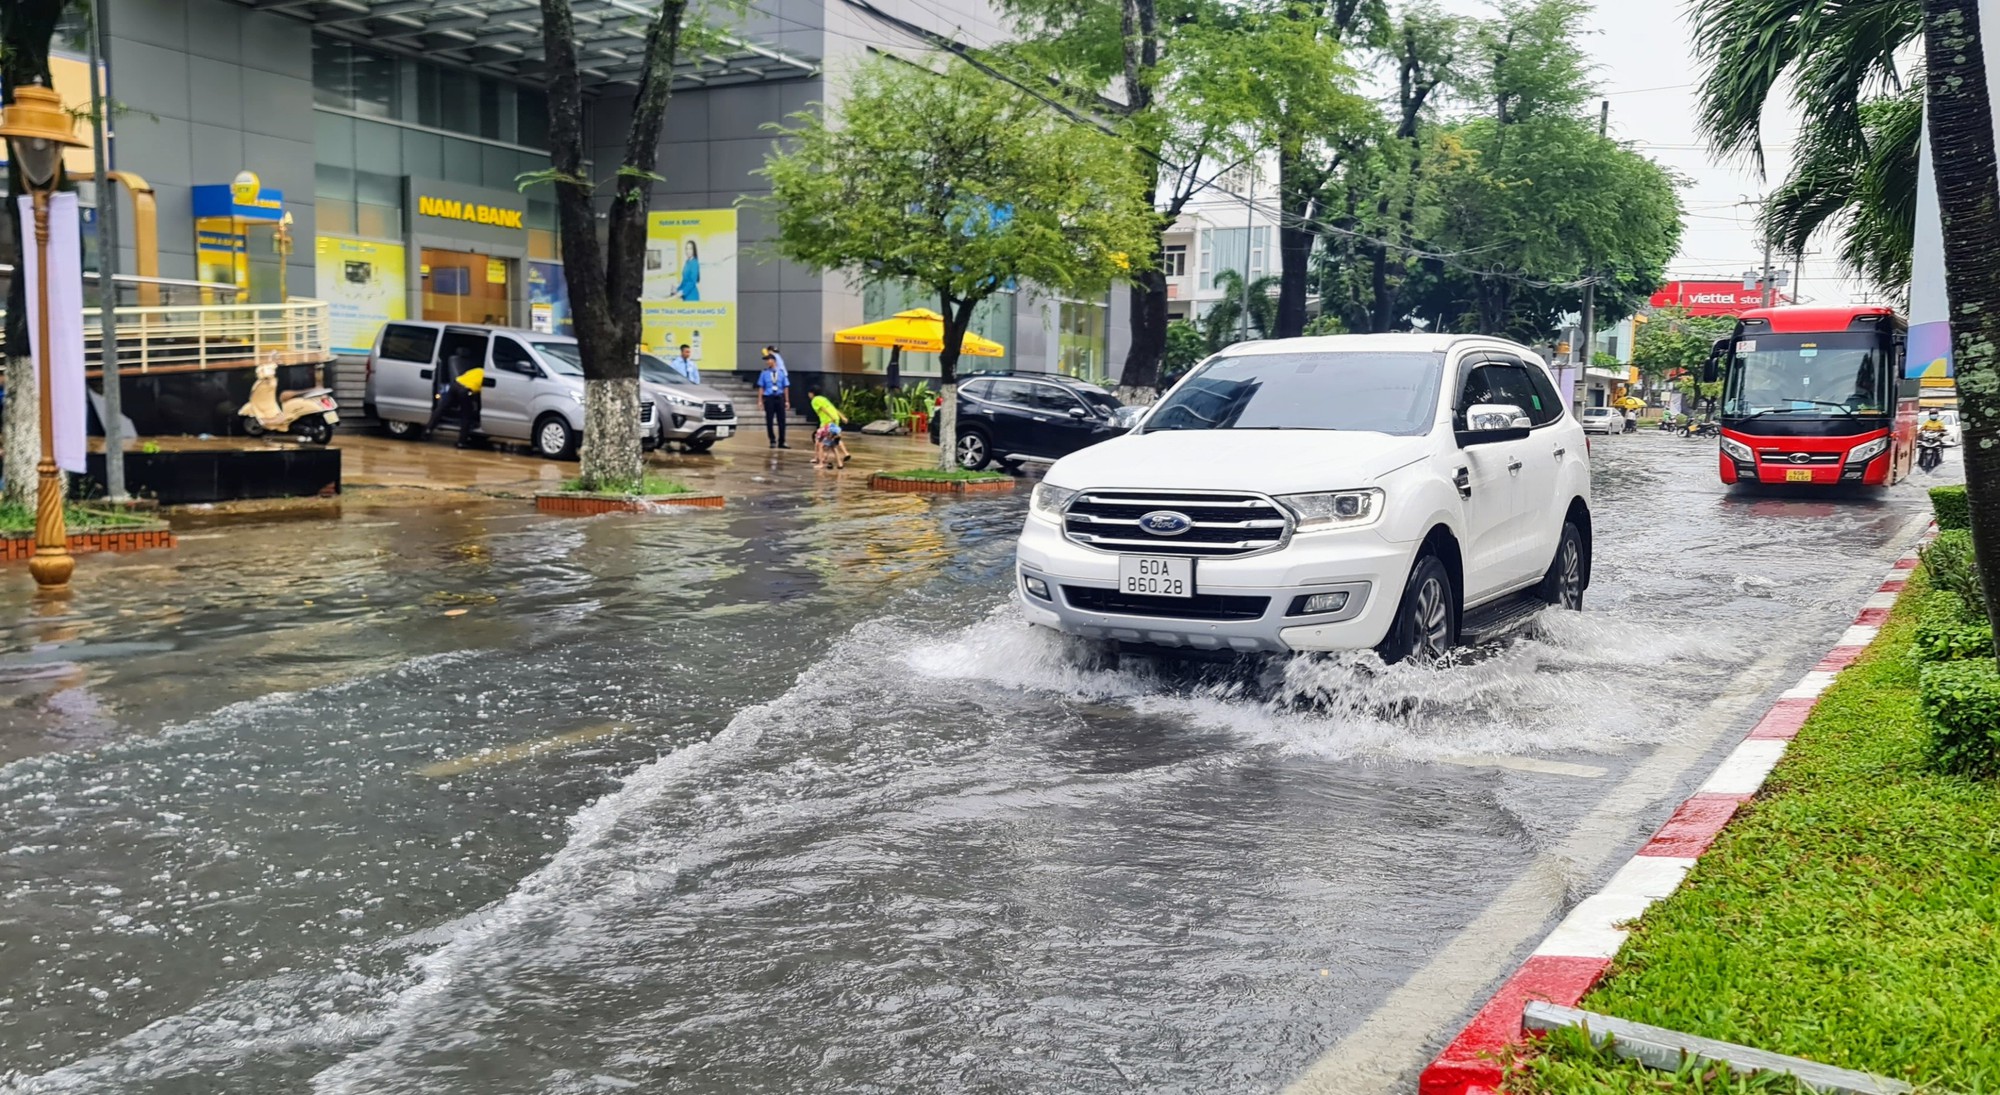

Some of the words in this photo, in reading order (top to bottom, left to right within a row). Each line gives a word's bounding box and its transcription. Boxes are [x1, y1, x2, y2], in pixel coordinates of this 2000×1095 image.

[418, 196, 461, 220] NAM
[463, 203, 476, 222] A
[477, 205, 523, 229] BANK
[1689, 293, 1736, 304] viettel
[1149, 515, 1178, 529] Ford
[1140, 560, 1169, 576] 60A
[1128, 577, 1183, 594] 860.28
